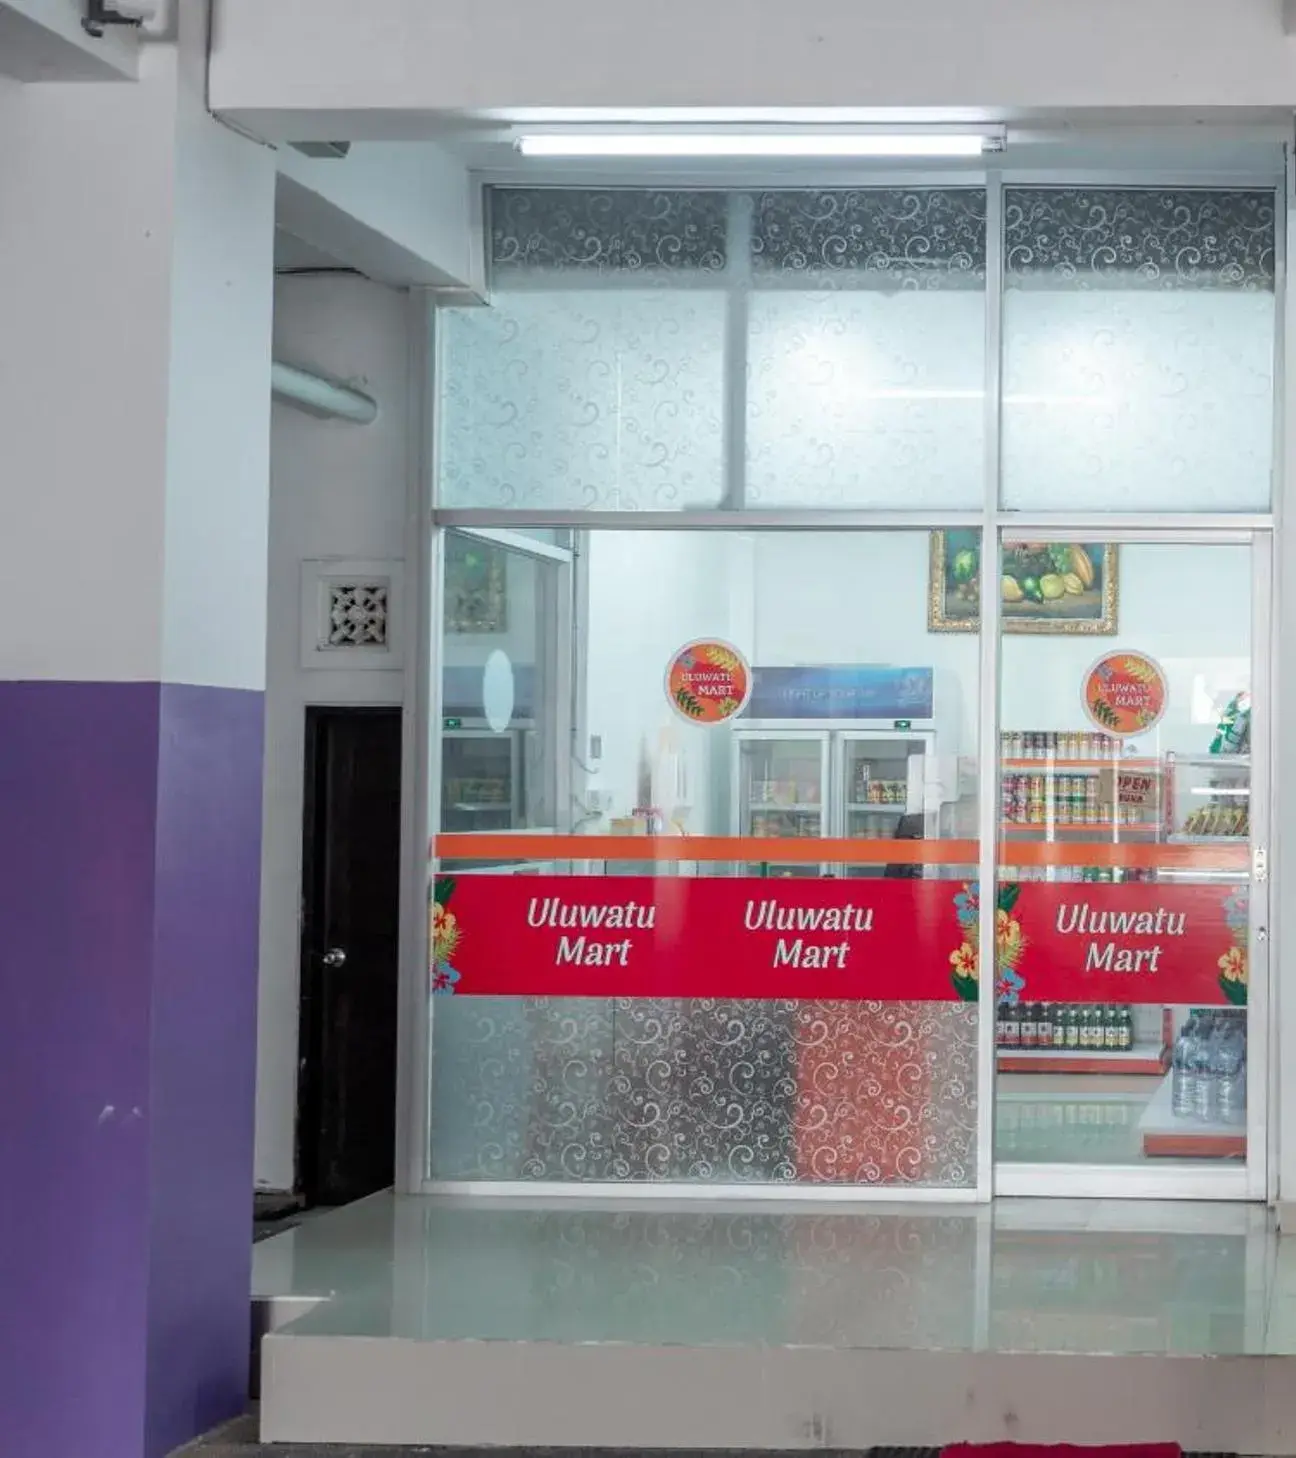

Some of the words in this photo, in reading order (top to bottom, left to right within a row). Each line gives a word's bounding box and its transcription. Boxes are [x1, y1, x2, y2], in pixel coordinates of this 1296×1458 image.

[698, 684, 734, 696] MART
[527, 897, 656, 928] Uluwatu
[744, 899, 874, 931] Uluwatu
[1056, 903, 1186, 935] Uluwatu
[555, 935, 633, 966] Mart
[773, 938, 851, 968] Mart
[1086, 942, 1163, 972] Mart
